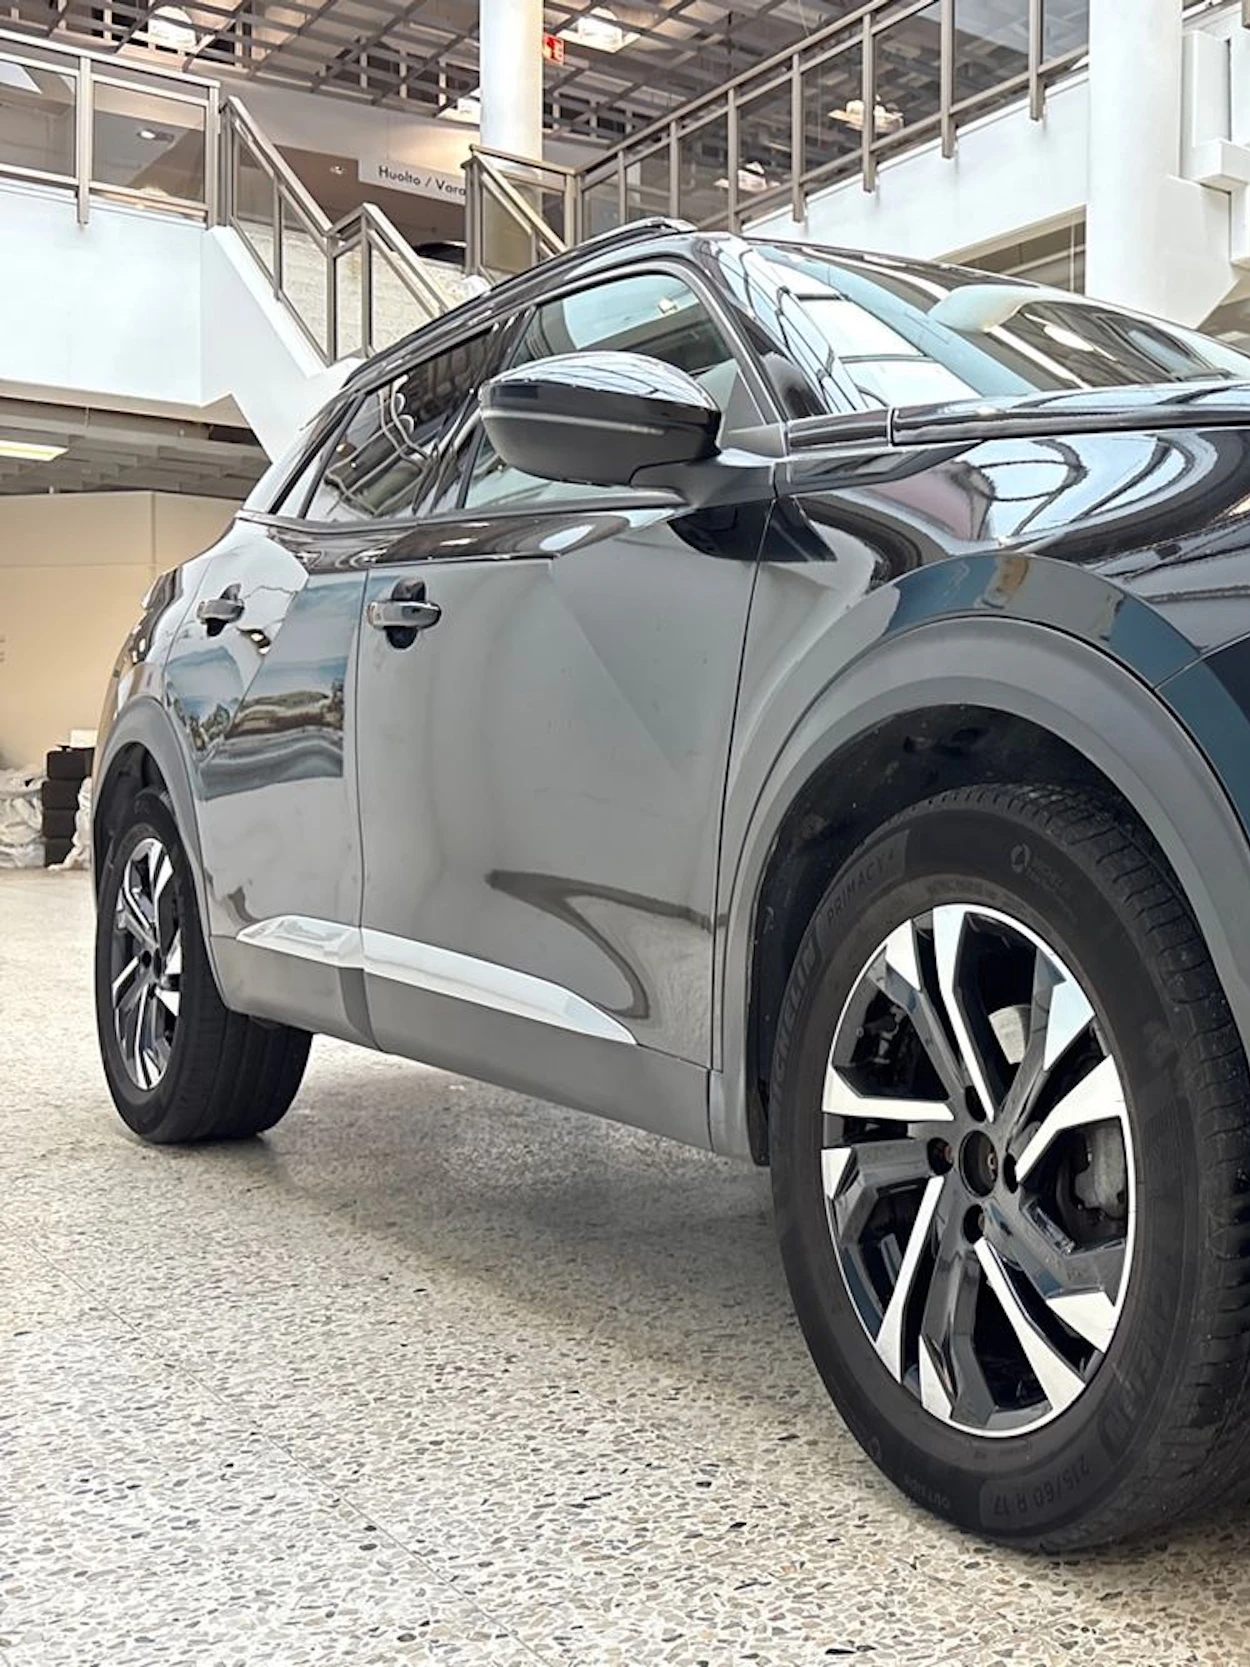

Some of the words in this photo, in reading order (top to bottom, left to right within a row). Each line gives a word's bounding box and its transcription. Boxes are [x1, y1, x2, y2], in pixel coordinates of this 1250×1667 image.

[379, 166, 421, 185] Huolto
[1032, 1453, 1092, 1510] 215/60
[993, 1492, 1010, 1516] 17
